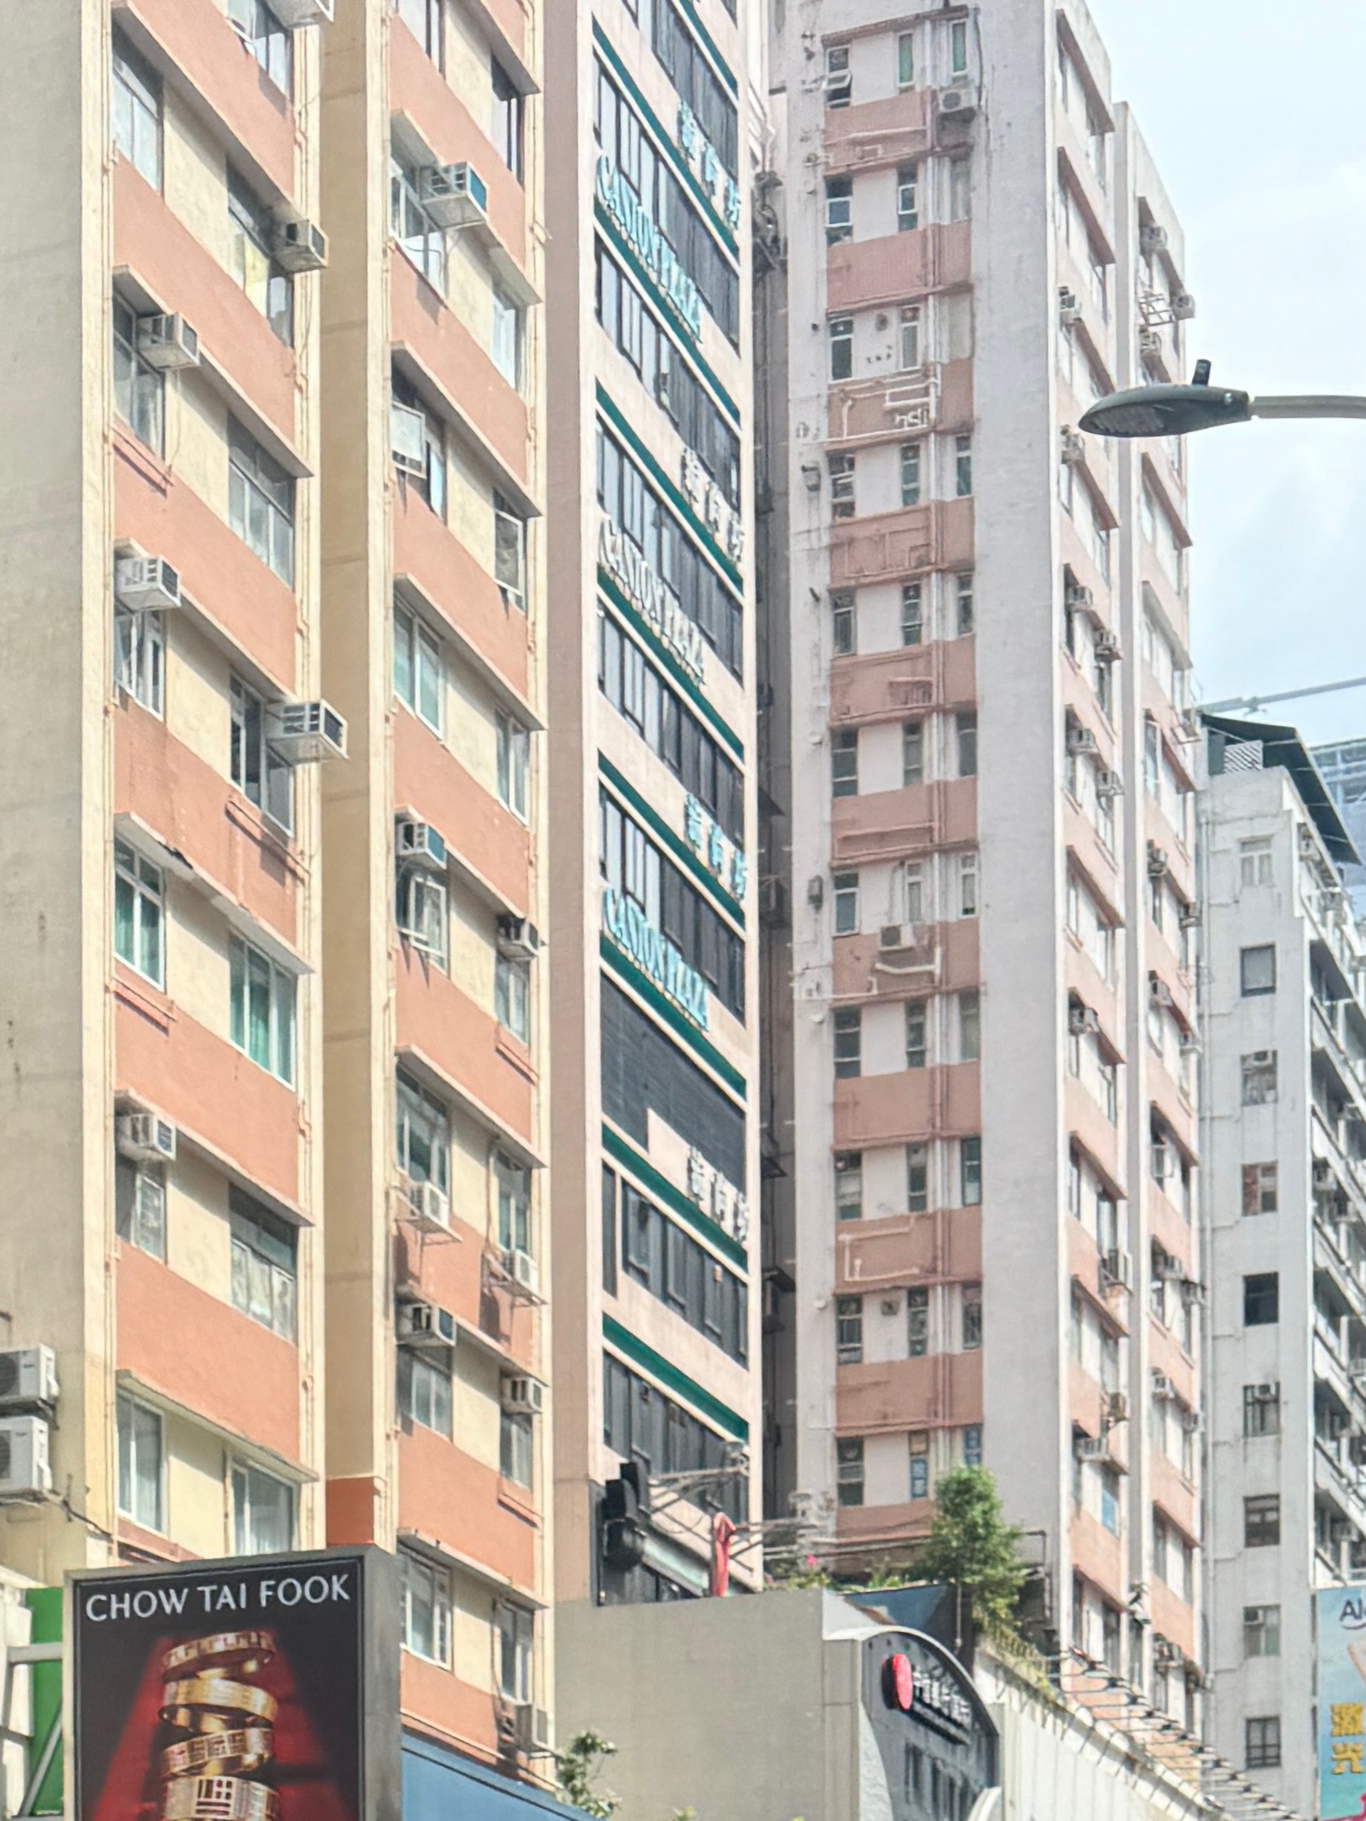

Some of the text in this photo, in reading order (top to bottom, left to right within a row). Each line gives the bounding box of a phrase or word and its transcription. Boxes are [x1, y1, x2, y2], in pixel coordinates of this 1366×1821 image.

[595, 153, 658, 273] CANTON
[603, 884, 665, 990] CANTON
[85, 1573, 351, 1622] CHOW TAI FOOK
